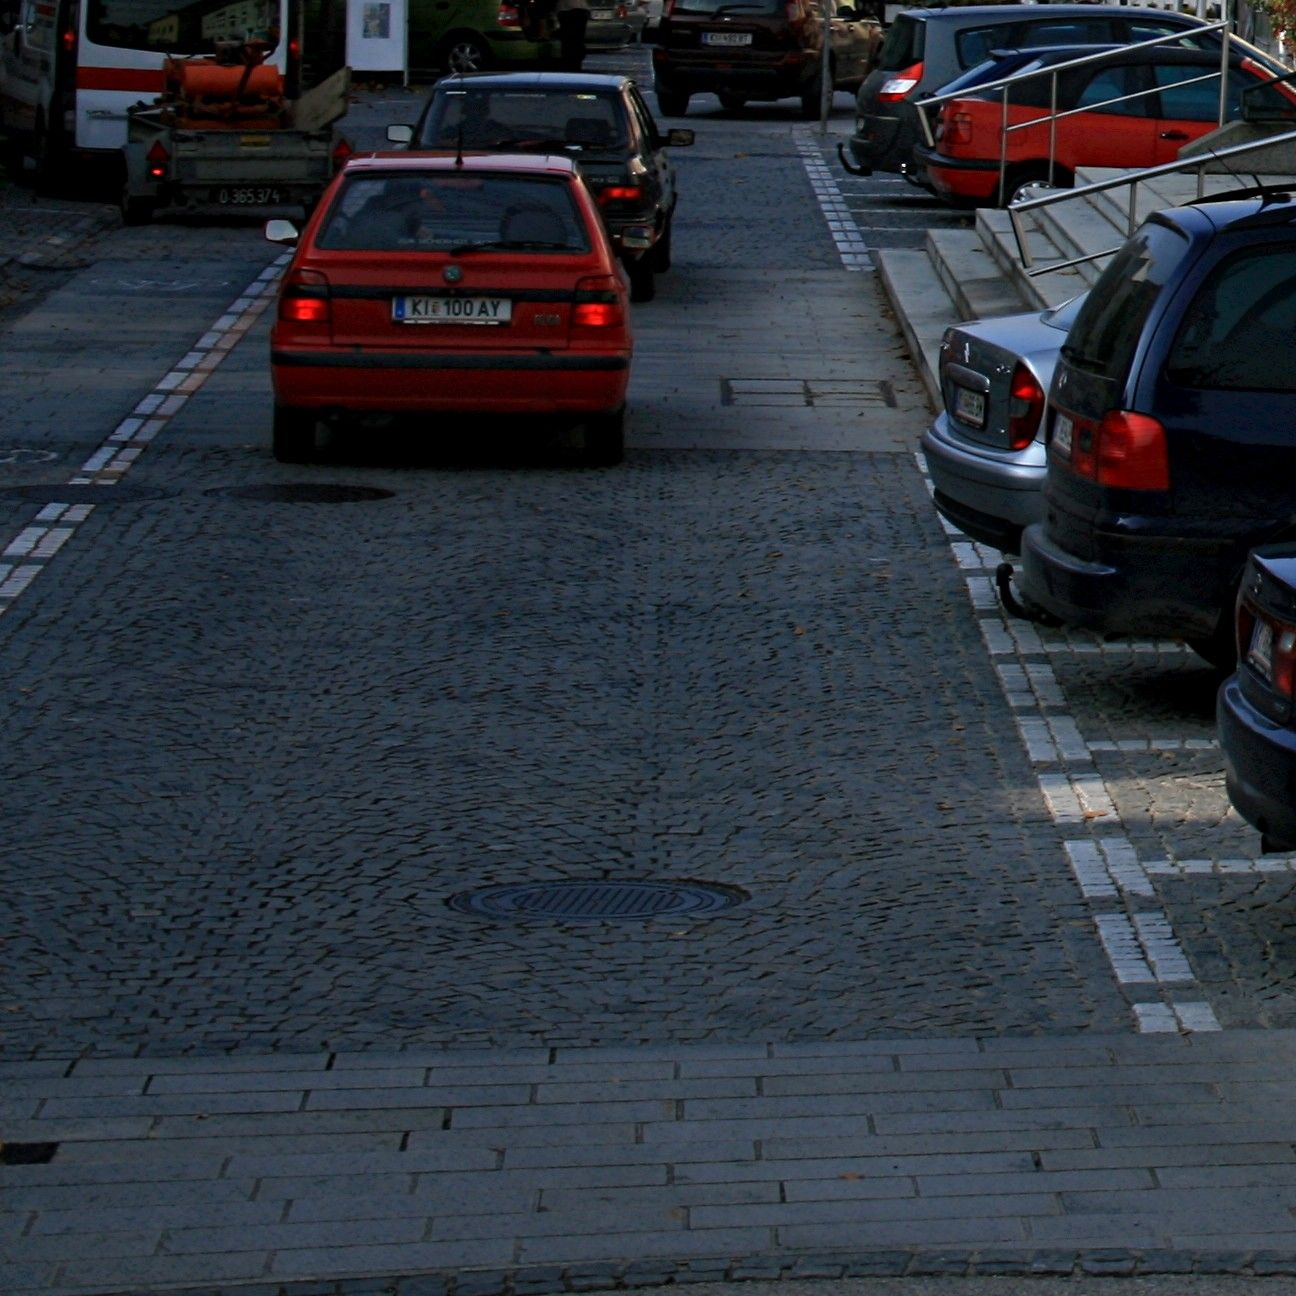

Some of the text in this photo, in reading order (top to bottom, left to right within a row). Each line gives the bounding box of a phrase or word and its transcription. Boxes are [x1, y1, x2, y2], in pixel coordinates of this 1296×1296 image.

[411, 298, 501, 317] KI 100 AY
